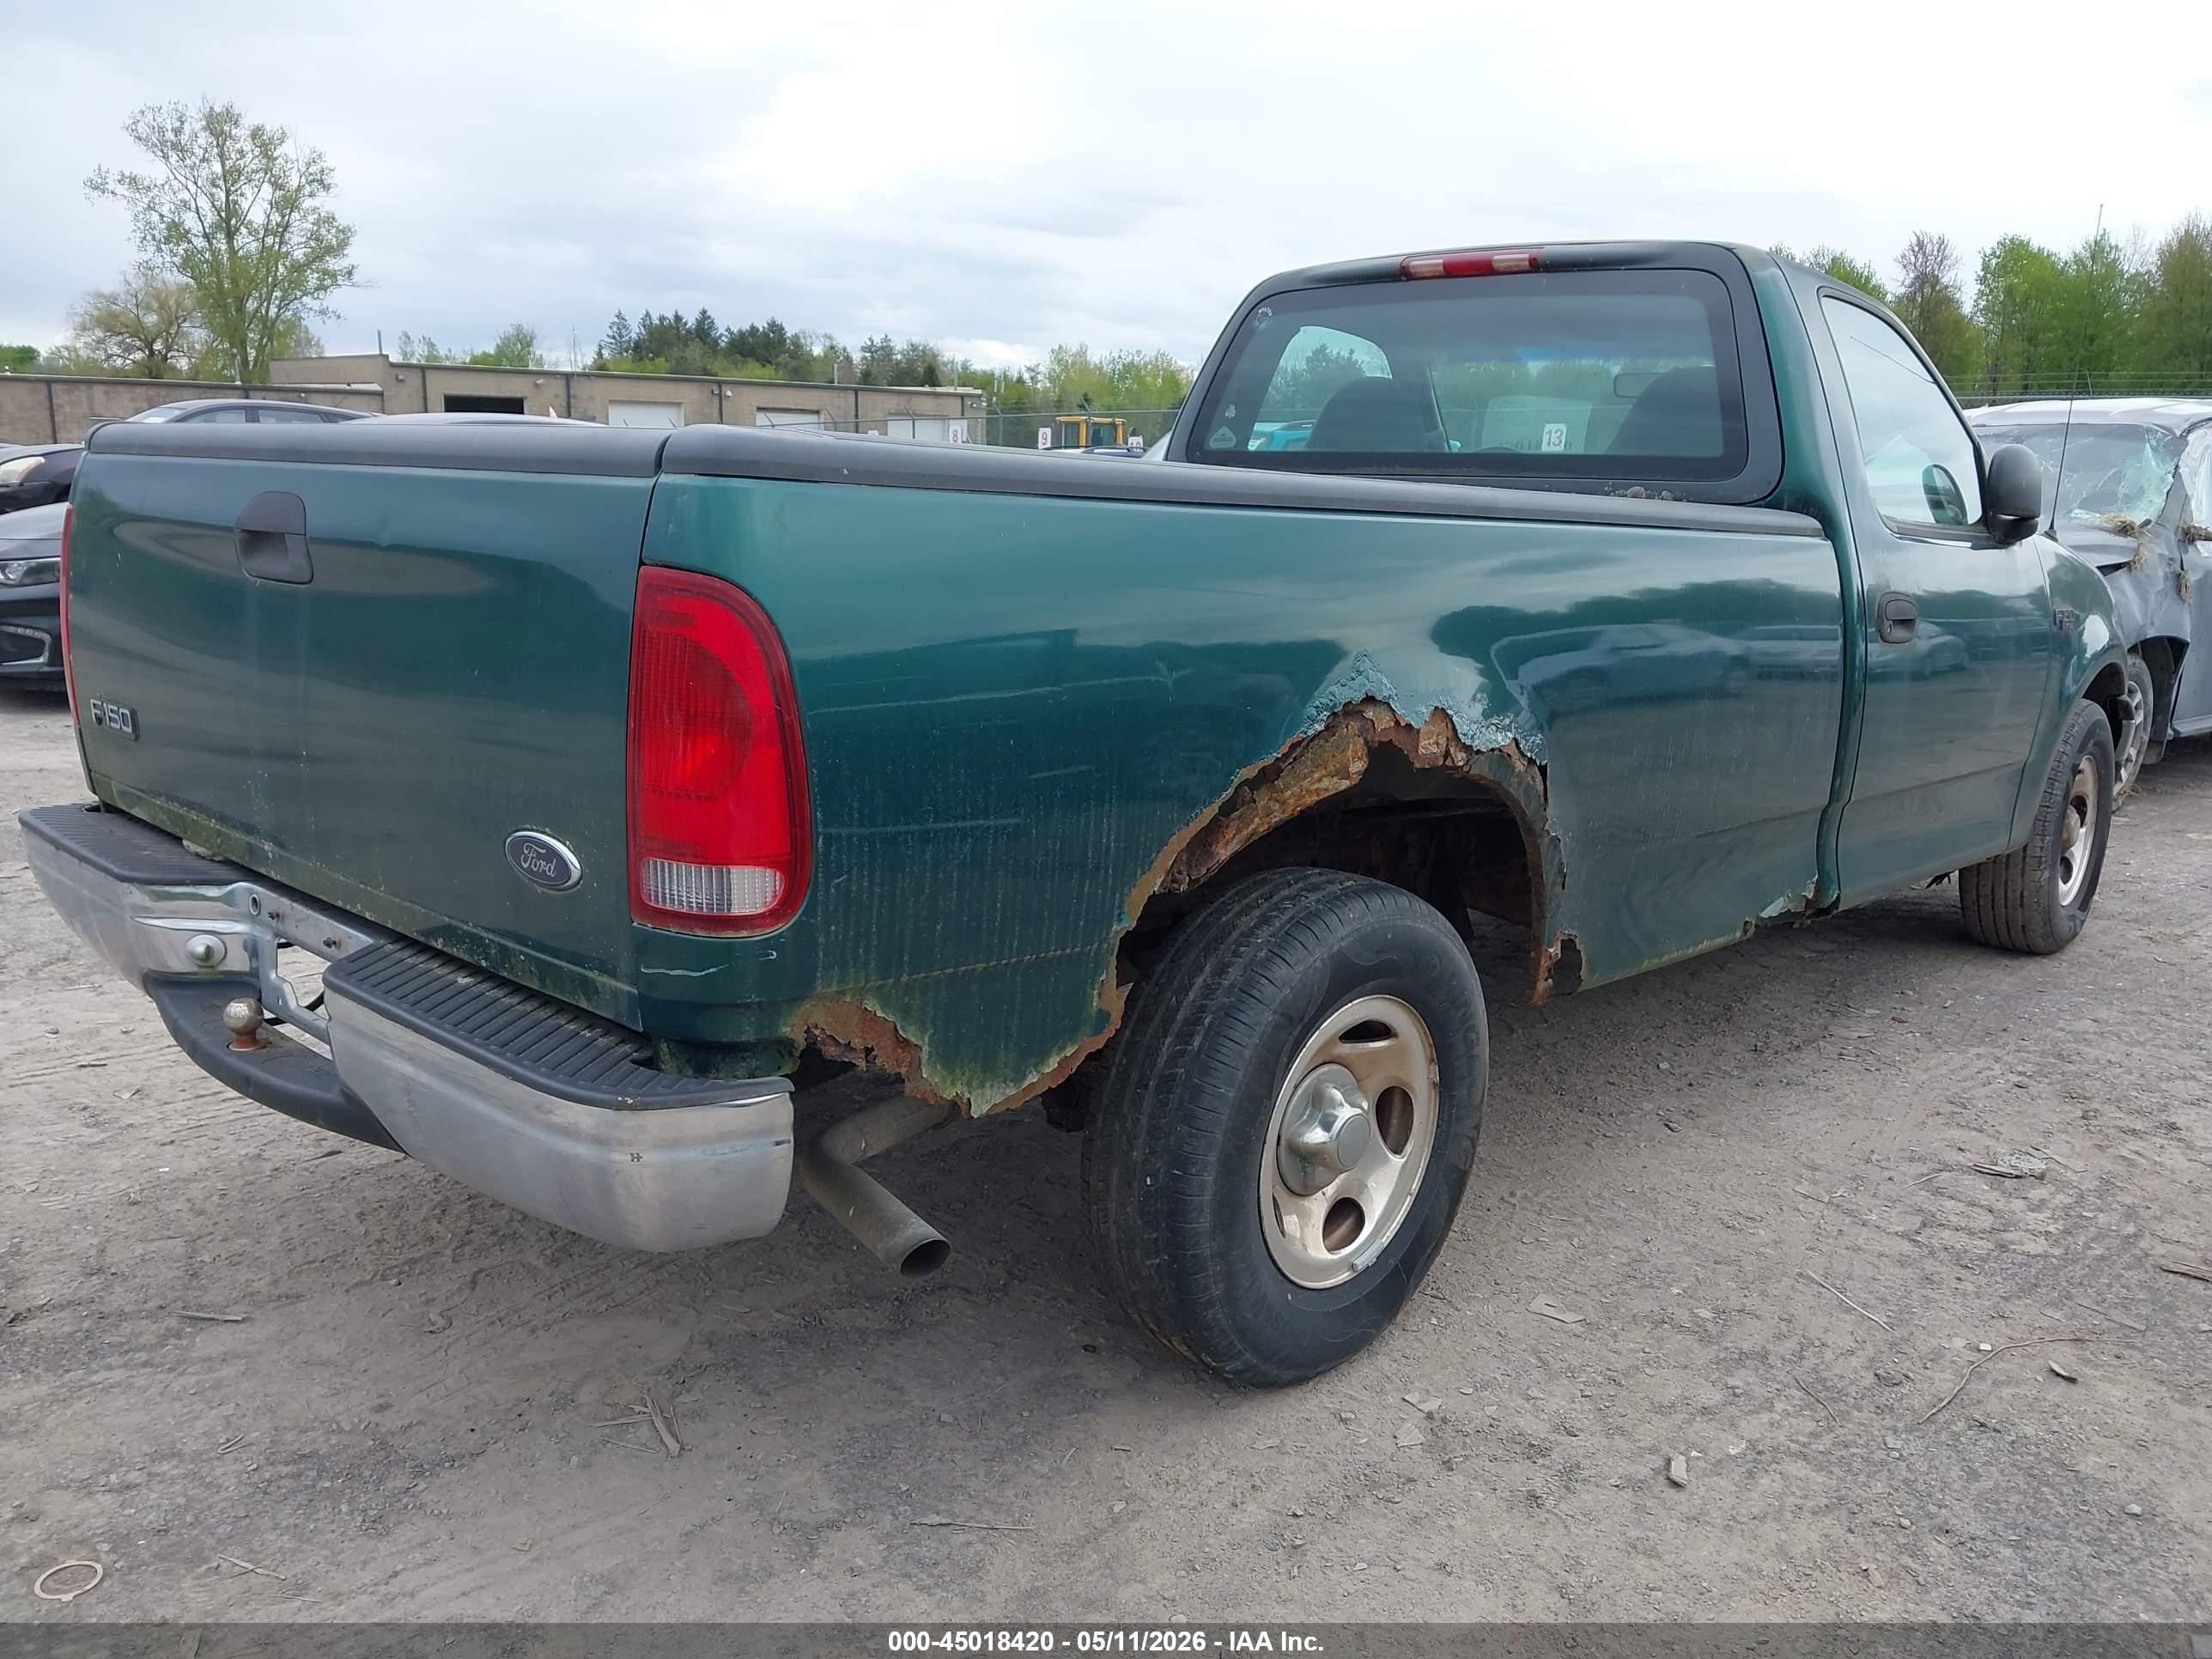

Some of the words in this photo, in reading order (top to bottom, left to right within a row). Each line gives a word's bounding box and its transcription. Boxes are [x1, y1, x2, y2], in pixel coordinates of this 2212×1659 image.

[952, 428, 958, 444] 8
[1042, 431, 1048, 447] 9
[1545, 428, 1564, 447] 13
[520, 842, 556, 877] Ford
